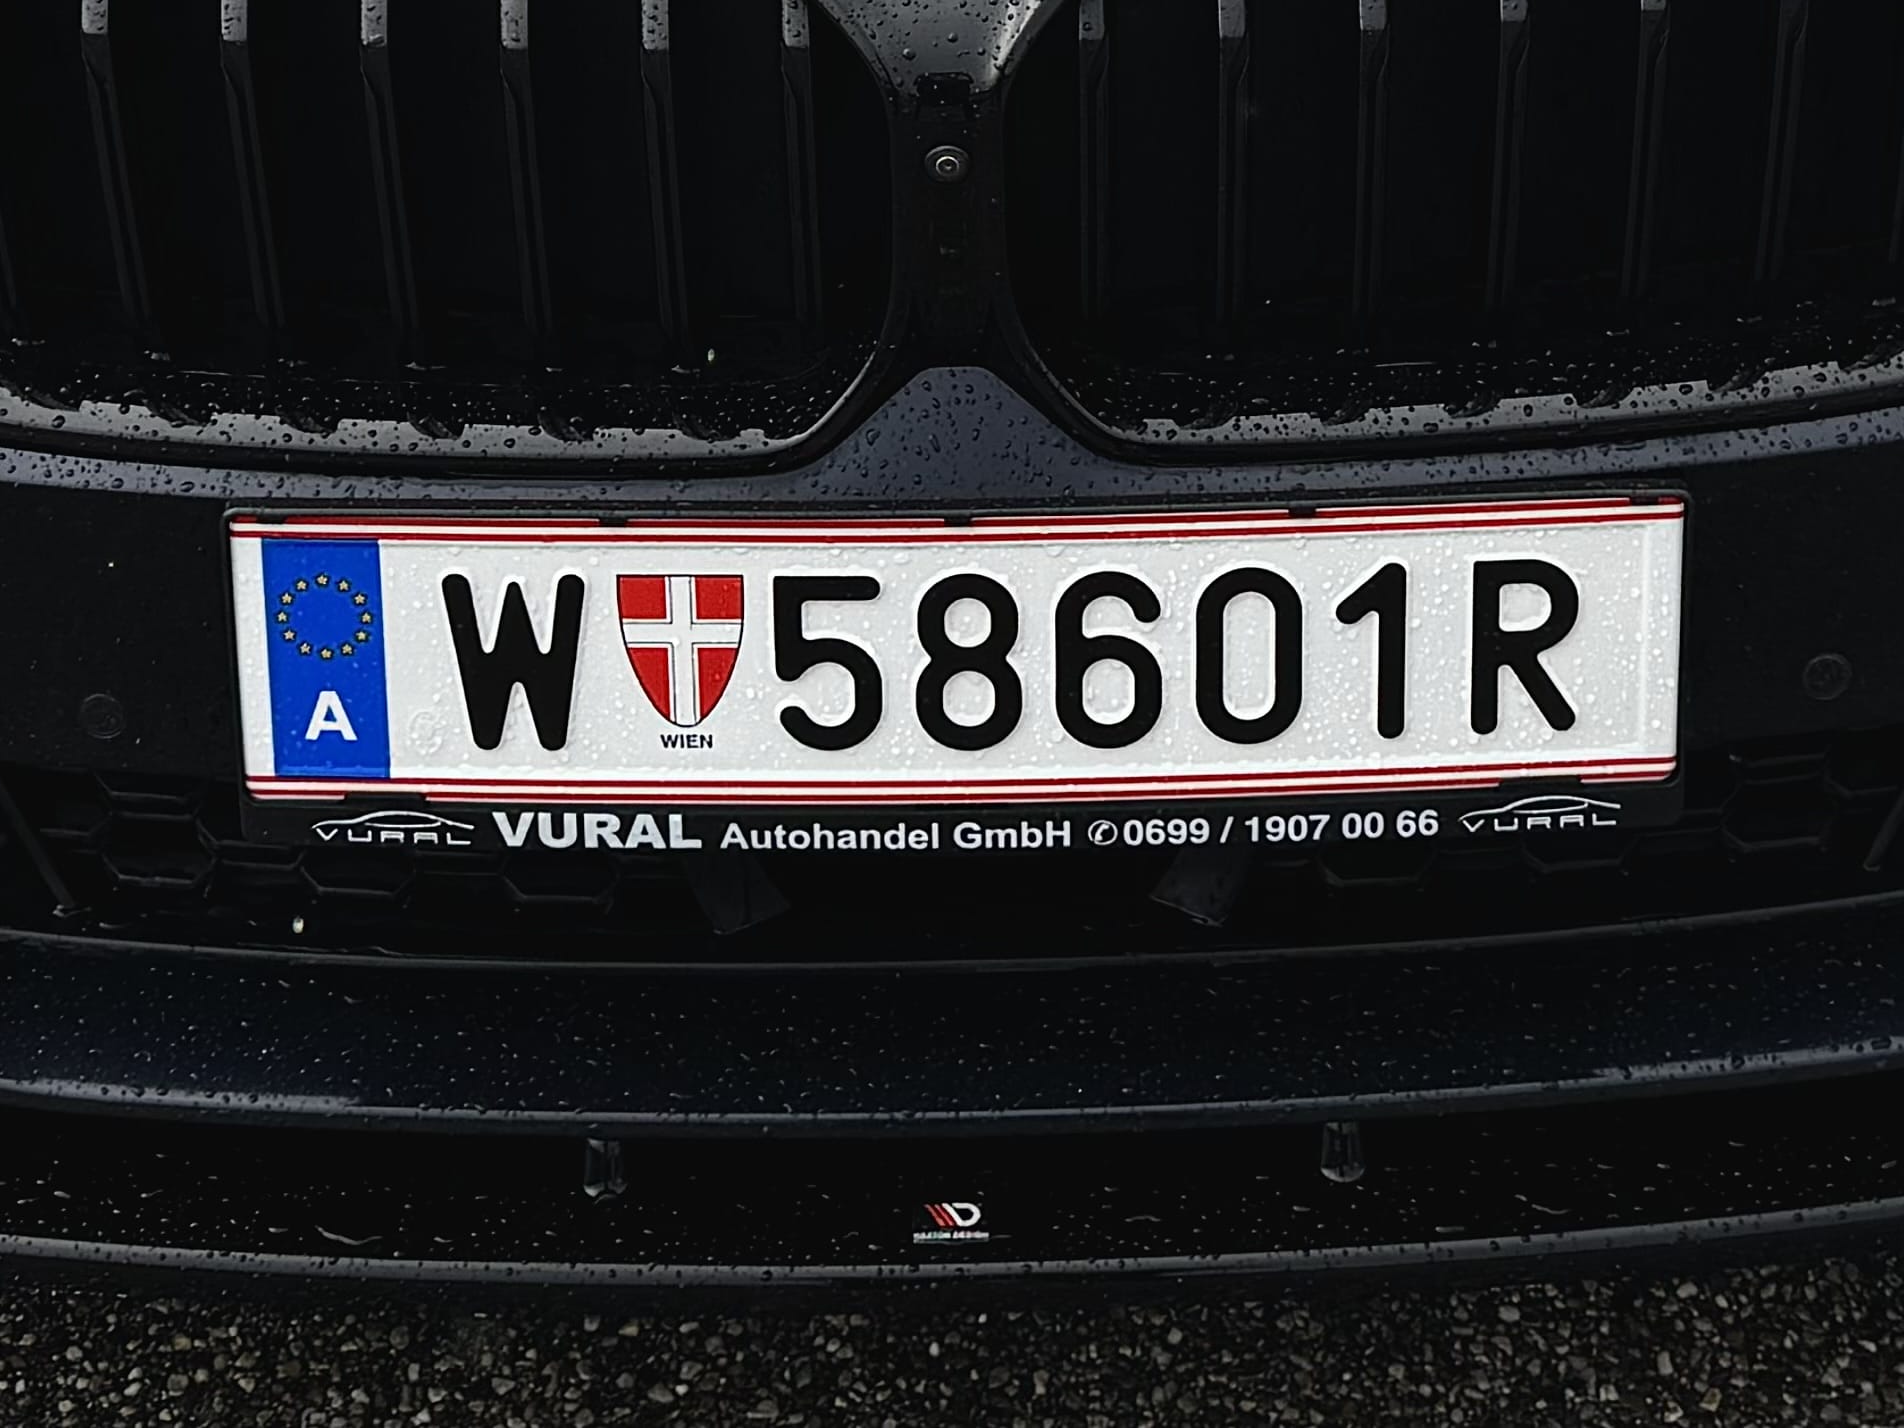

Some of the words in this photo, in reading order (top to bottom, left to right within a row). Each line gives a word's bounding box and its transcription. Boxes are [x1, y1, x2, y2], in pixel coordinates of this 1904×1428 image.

[441, 573, 586, 751] W
[772, 558, 1580, 751] 58601R
[304, 690, 358, 741] A
[659, 733, 714, 750] WIEN
[315, 827, 472, 845] VURAL
[492, 811, 702, 849] VURAL
[720, 822, 939, 850] Autohandel
[953, 820, 1071, 849] GmbH
[1244, 813, 1331, 843] 1907
[1341, 811, 1386, 840] 00
[1396, 808, 1440, 838] 66
[1462, 813, 1617, 832] VURAL
